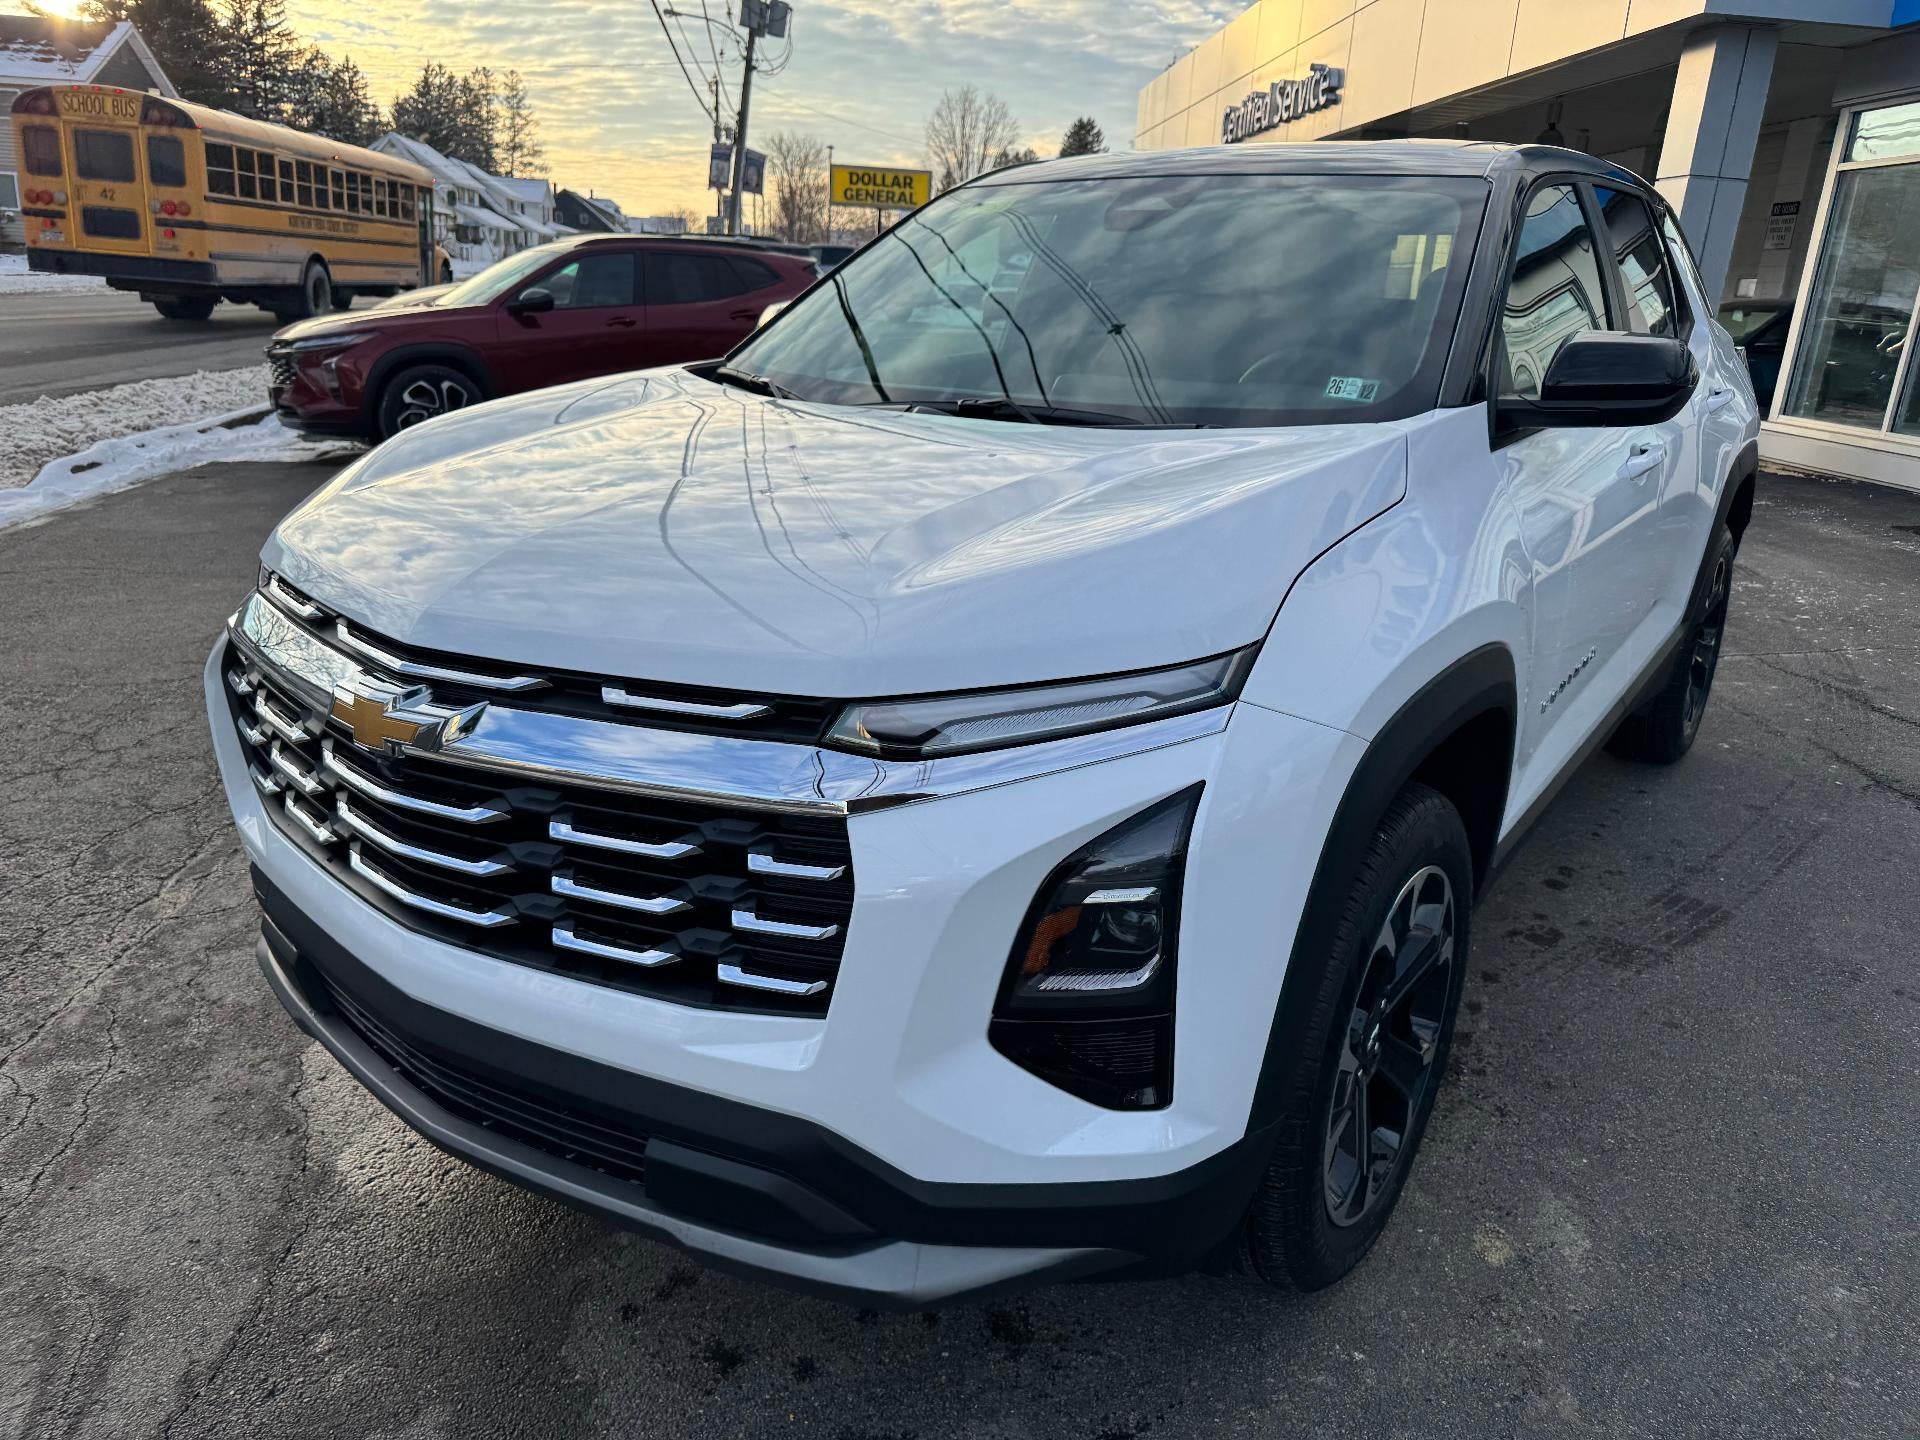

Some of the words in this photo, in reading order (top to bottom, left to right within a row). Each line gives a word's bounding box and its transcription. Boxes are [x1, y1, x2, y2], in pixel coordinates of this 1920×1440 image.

[63, 93, 108, 115] SCHOOL
[112, 96, 136, 117] BUS
[1222, 89, 1274, 143] Certified
[1273, 66, 1333, 122] Service
[848, 172, 914, 190] DOLLAR
[100, 187, 115, 201] 42
[843, 187, 917, 206] GENERAL
[1328, 378, 1344, 395] 26
[1359, 383, 1376, 400] 12
